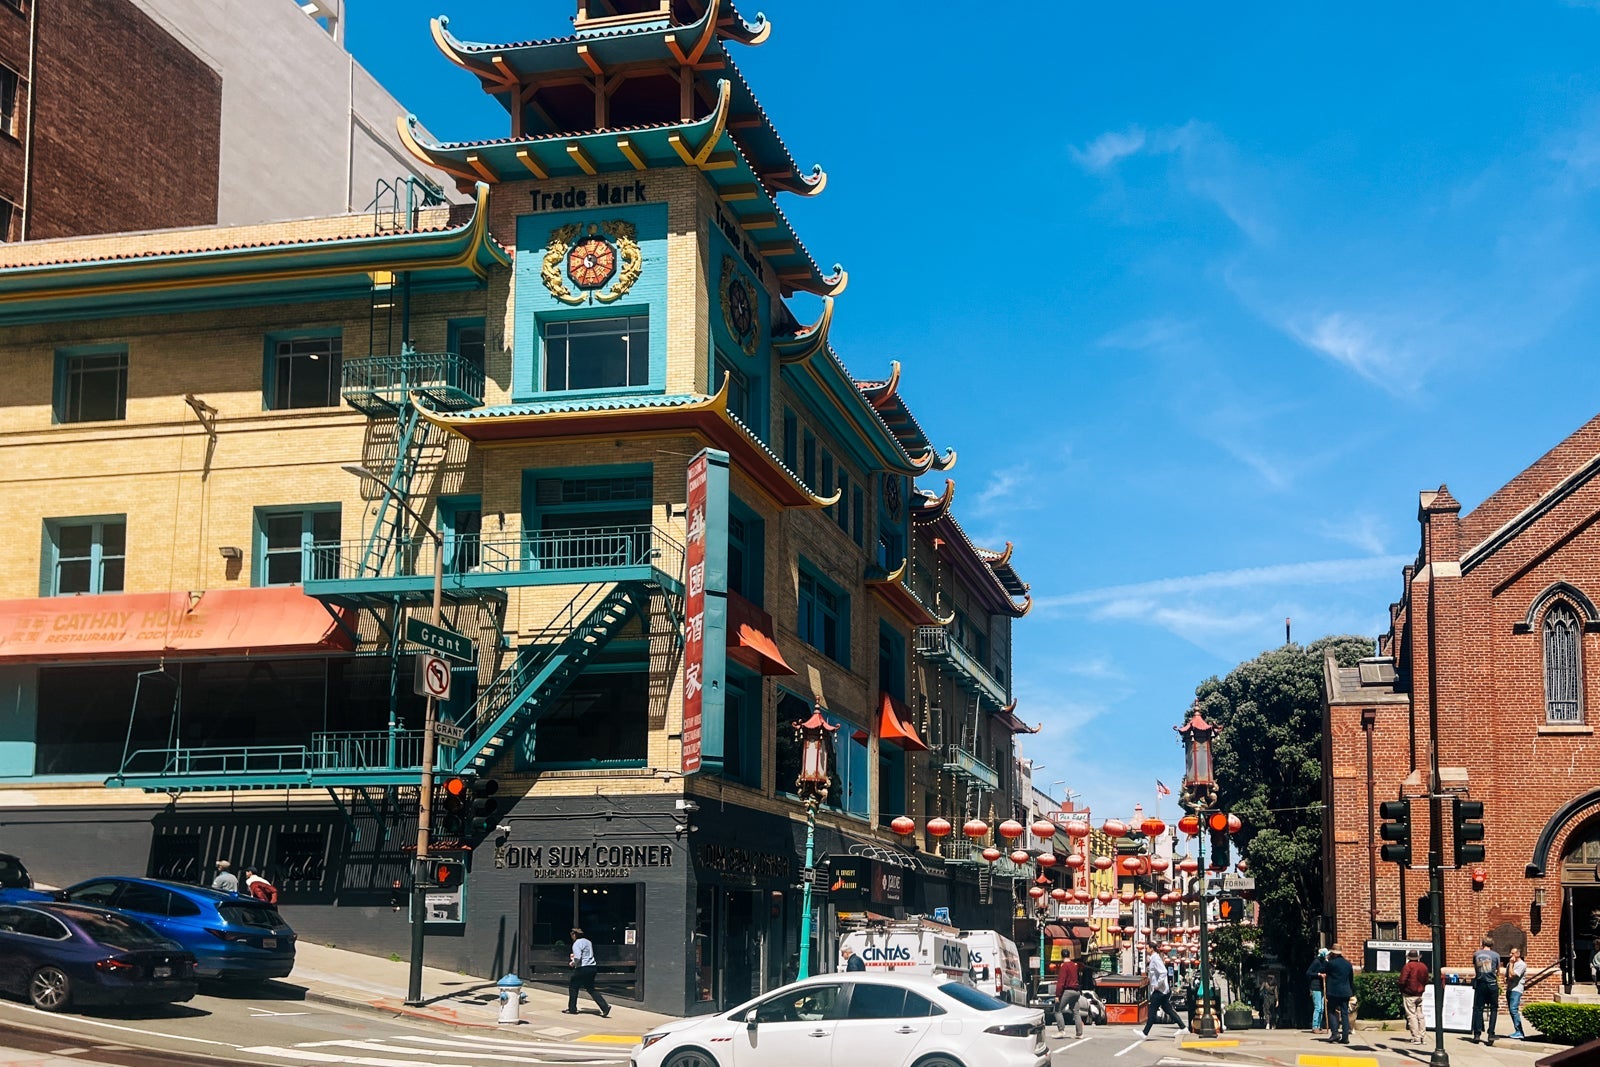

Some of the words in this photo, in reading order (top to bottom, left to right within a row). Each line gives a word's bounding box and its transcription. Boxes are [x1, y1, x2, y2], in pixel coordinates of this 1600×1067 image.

[529, 186, 587, 211] Trade
[597, 180, 646, 205] Mark
[52, 610, 135, 631] CATHAY
[45, 631, 127, 643] RESTAURANT
[421, 628, 460, 652] Grant
[436, 724, 463, 737] GRANT
[507, 845, 543, 868] DIM
[549, 845, 590, 868] SUM
[596, 844, 673, 868] CORNER
[534, 868, 577, 879] DUMPLINGS
[862, 944, 911, 961] CINTAS
